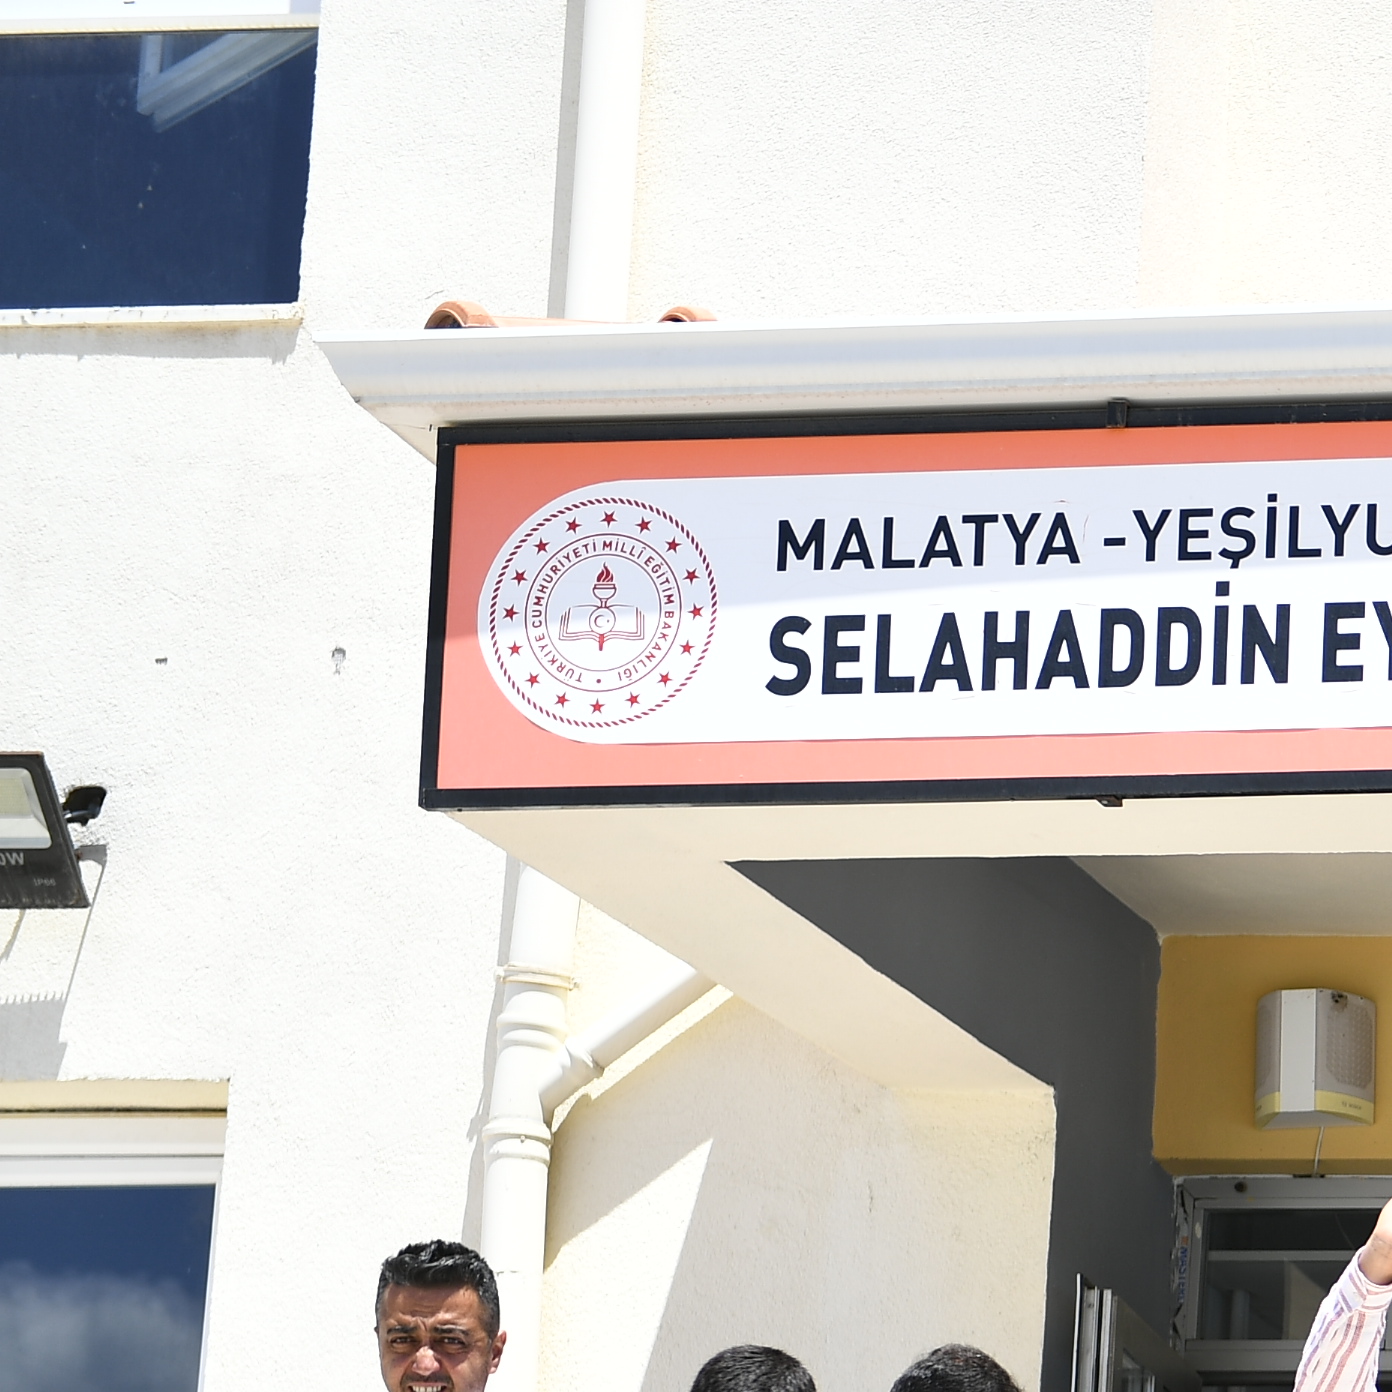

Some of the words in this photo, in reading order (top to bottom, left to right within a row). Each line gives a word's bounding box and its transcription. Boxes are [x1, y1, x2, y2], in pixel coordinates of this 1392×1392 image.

[602, 538, 646, 560] MİLLÎ
[777, 513, 1081, 571] MALATYA
[531, 538, 597, 629] CUMHURİYETİ
[643, 556, 676, 605] EĞİTİM
[534, 632, 583, 684] TÜRKİYE
[617, 610, 675, 682] BAKANLIĞI
[766, 580, 1290, 696] SELAHADDİN
